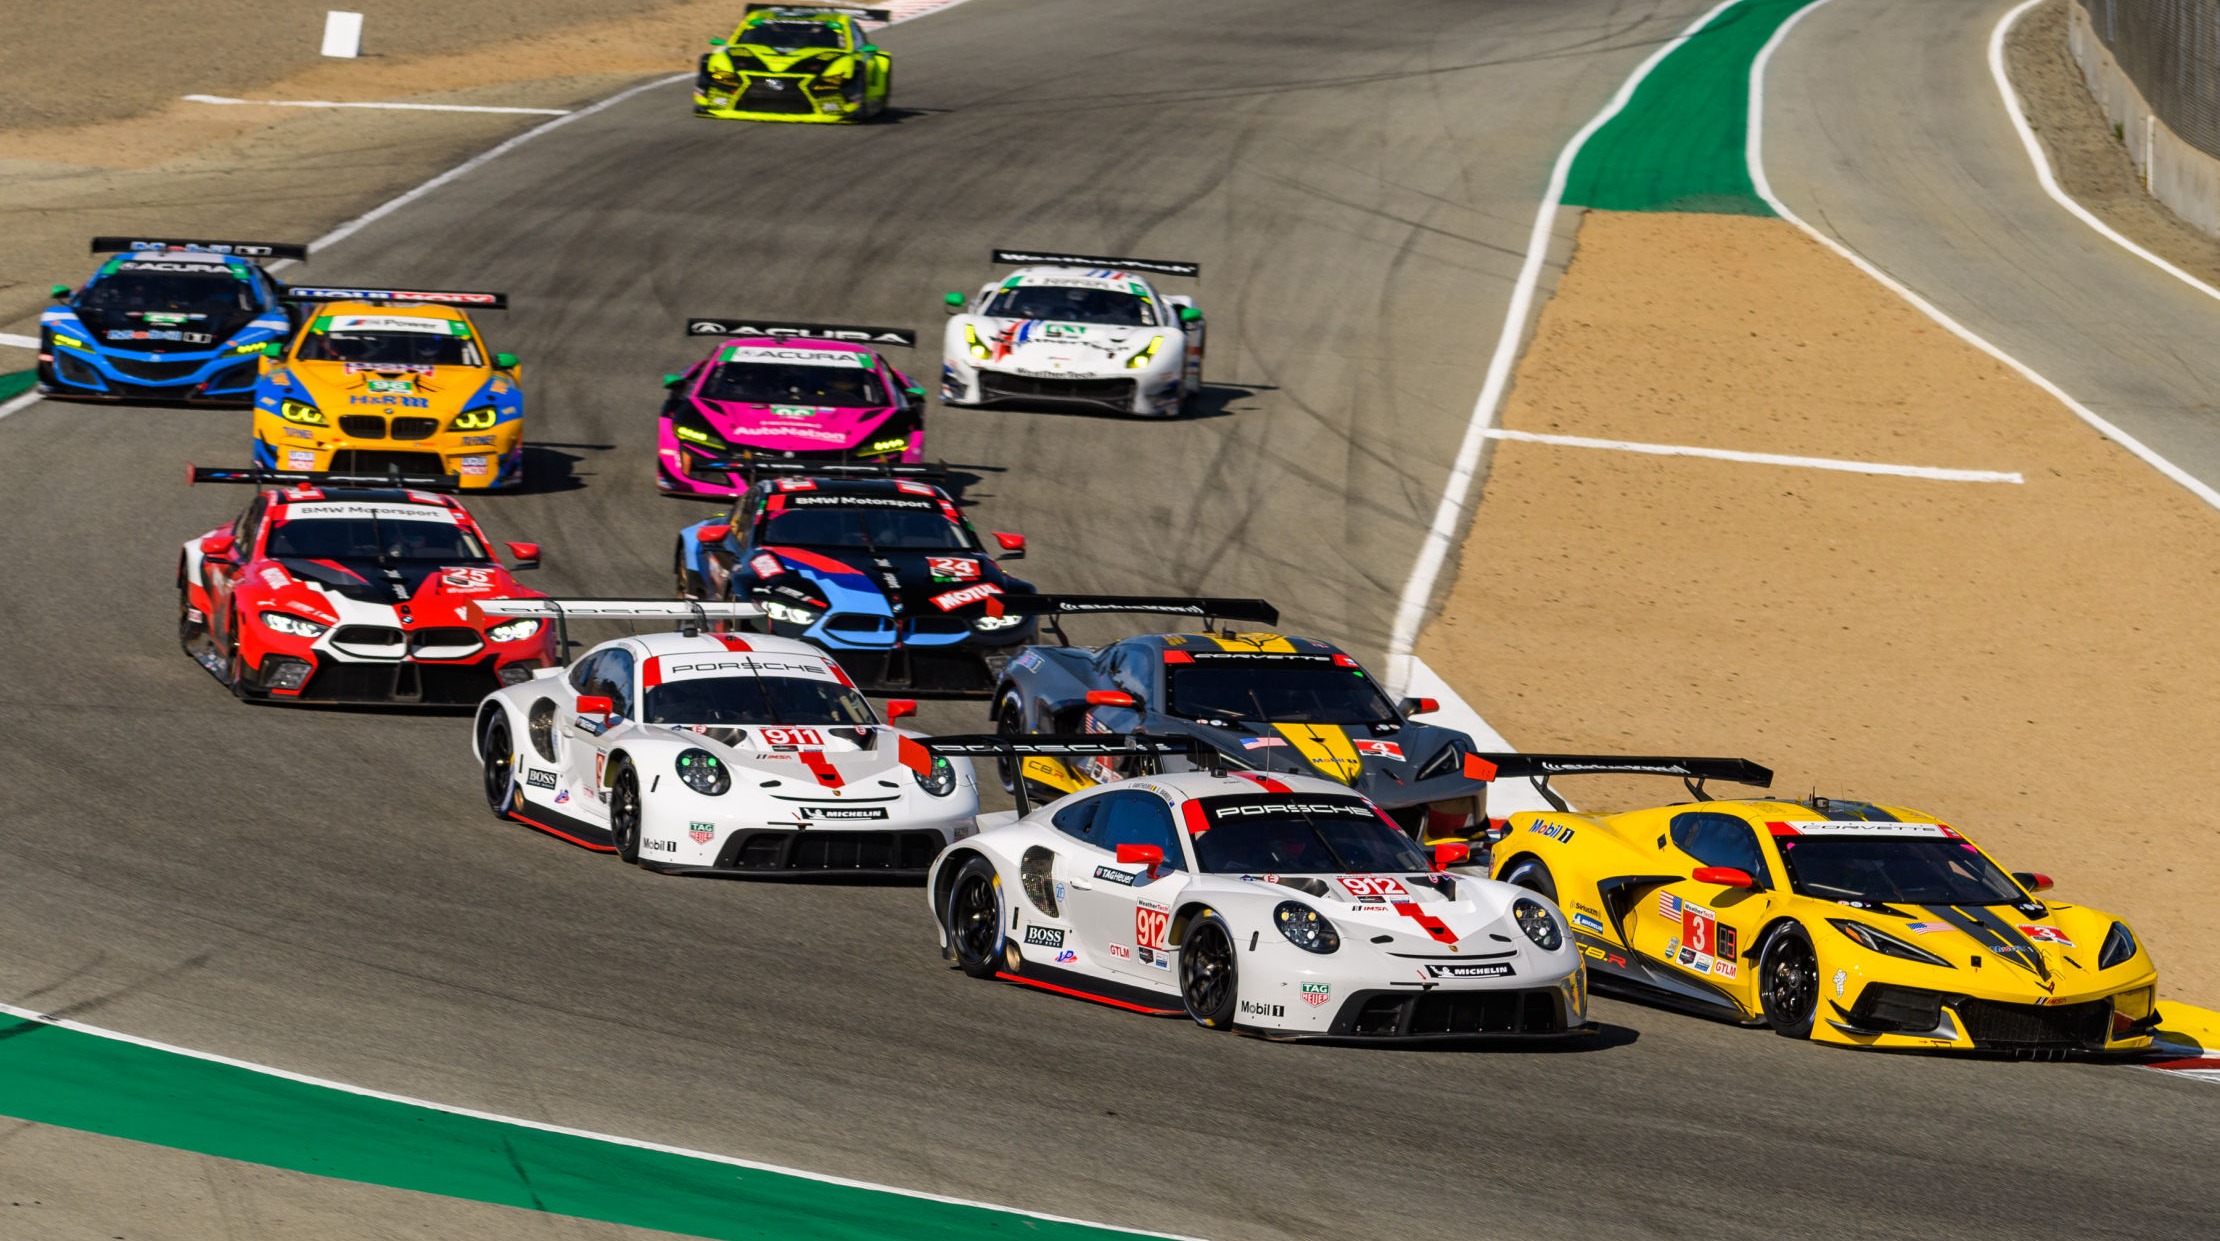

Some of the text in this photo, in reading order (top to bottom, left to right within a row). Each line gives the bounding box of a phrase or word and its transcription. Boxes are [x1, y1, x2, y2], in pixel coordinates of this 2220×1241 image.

[135, 262, 234, 274] ACURA
[728, 325, 911, 344] ACURA
[755, 350, 857, 363] ACURA
[795, 496, 931, 510] BMW Motorsport
[301, 504, 440, 518] BMW Motorsport
[935, 558, 975, 574] 24
[449, 567, 490, 583] 25
[936, 583, 1003, 609] MOTUL
[1193, 652, 1331, 663] CORVETTE
[672, 661, 827, 676] PORSCHE
[766, 728, 822, 745] 911
[1371, 741, 1389, 753] 4
[530, 770, 556, 786] BOSS
[826, 809, 882, 819] MICHELIN
[1216, 804, 1374, 819] PORSCHE
[692, 823, 714, 832] TAG
[1528, 818, 1563, 839] Mobil
[643, 837, 665, 851] Mobil
[1342, 878, 1406, 895] 912
[1028, 926, 1063, 943] BOSS
[1137, 909, 1167, 948] 912
[1692, 916, 1706, 951] 3
[2034, 926, 2058, 938] 3
[1110, 944, 1131, 959] GTLM
[1454, 966, 1508, 976] MICHELIN
[1716, 961, 1737, 977] GTLM
[1304, 983, 1328, 993] TAG
[1301, 992, 1329, 1008] HEUER
[1241, 1000, 1270, 1016] Mobil
